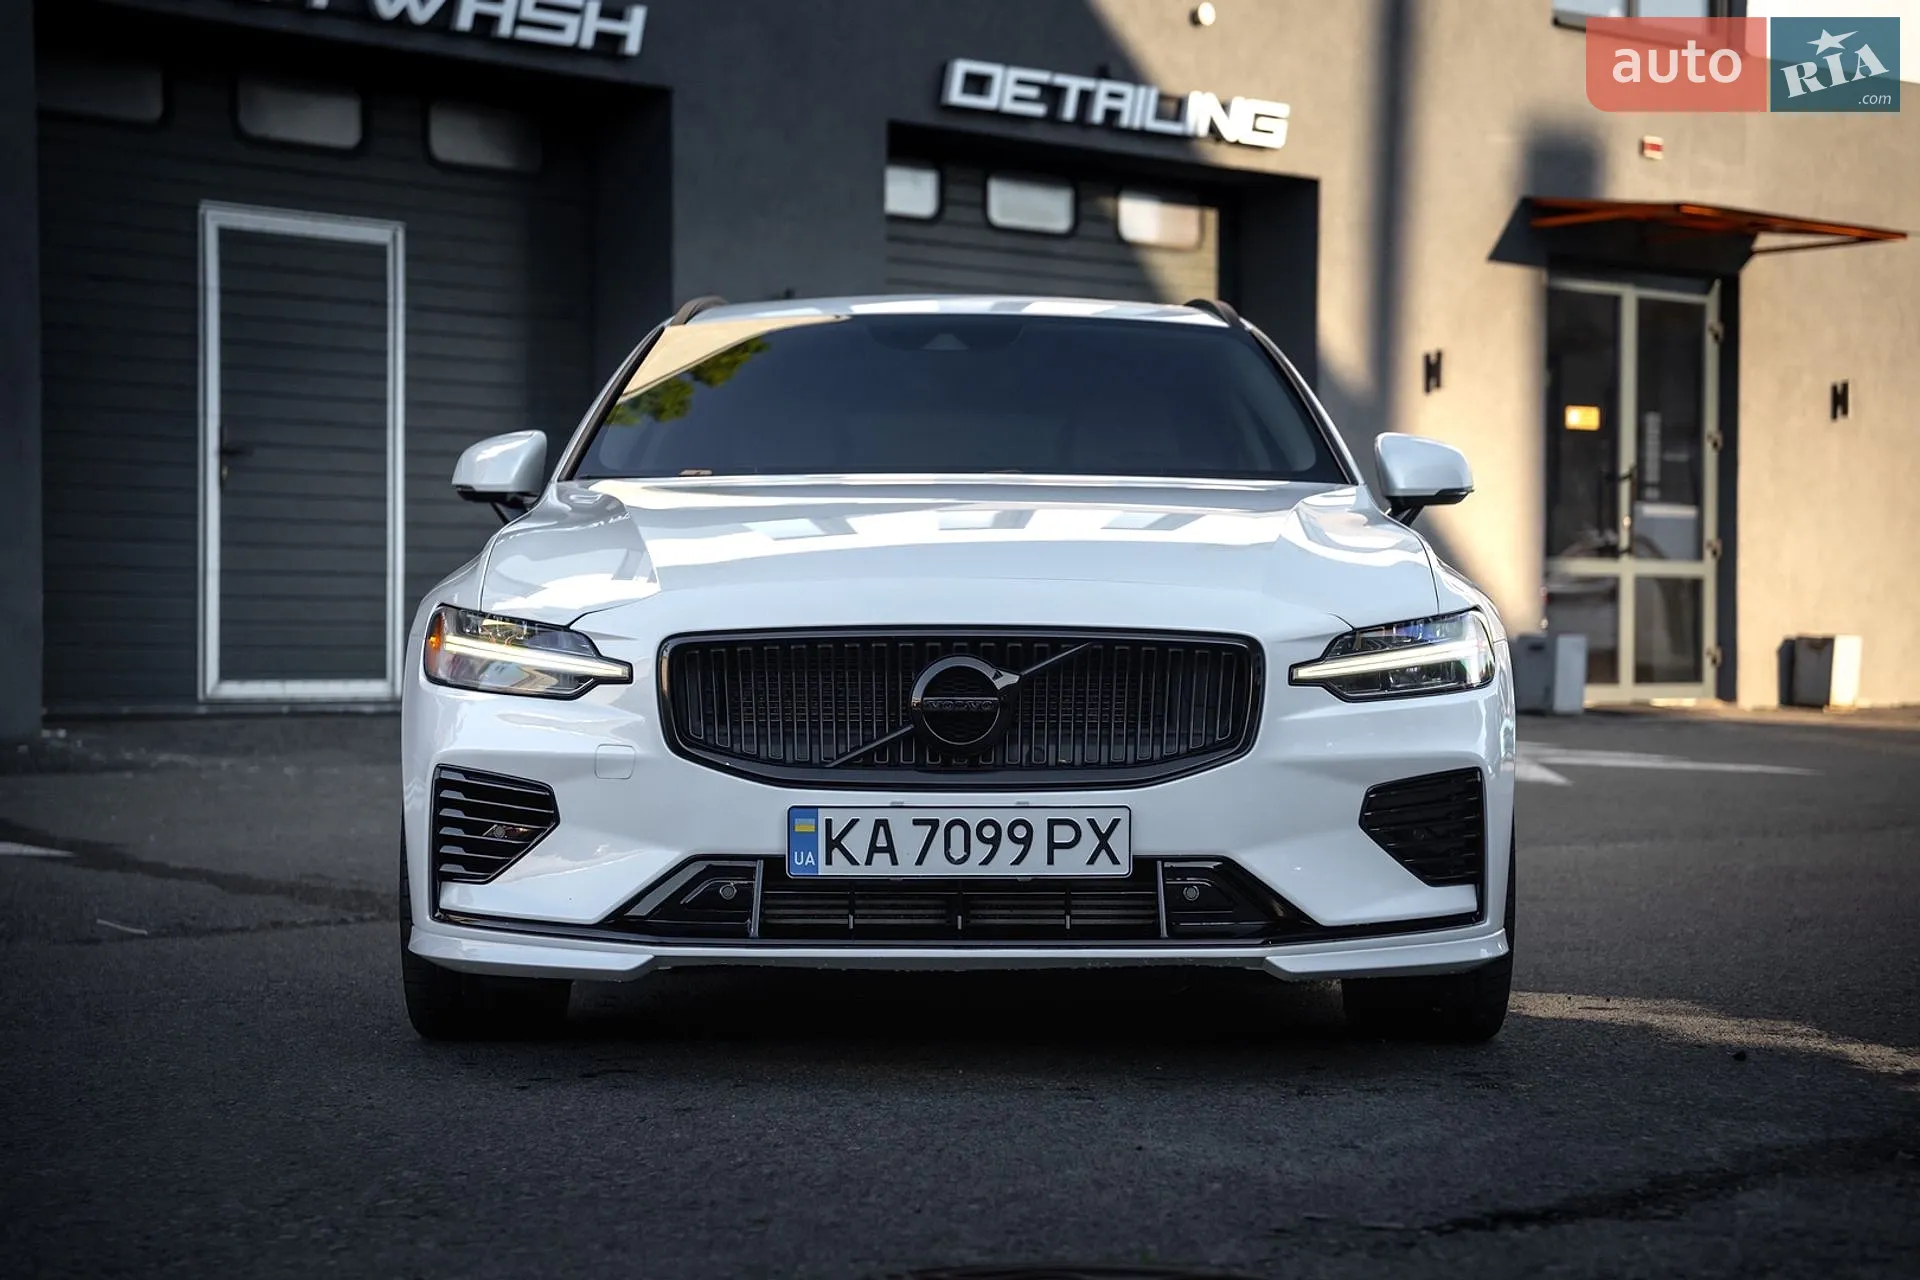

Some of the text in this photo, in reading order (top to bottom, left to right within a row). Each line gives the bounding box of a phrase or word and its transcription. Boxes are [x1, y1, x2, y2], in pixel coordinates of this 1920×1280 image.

[943, 58, 1291, 149] DETAILING
[794, 850, 816, 866] UA
[824, 817, 1122, 866] KA 7099 PX
